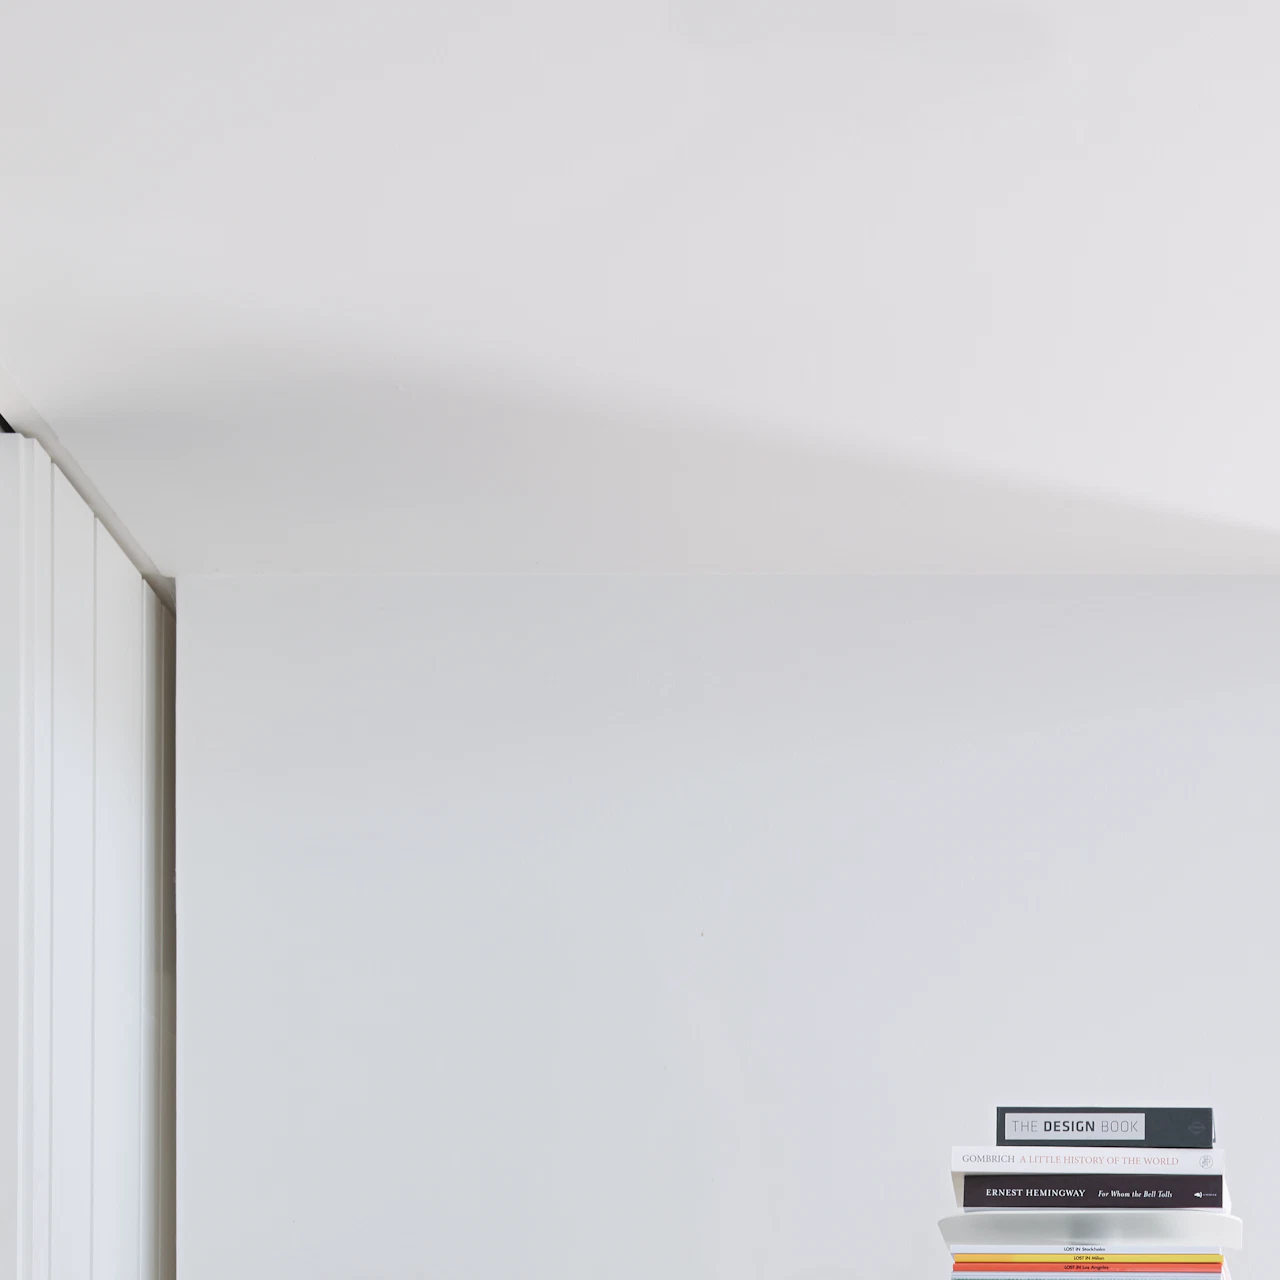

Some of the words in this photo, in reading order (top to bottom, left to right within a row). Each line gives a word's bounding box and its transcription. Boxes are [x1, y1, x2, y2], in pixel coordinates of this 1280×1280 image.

[1012, 1120, 1037, 1132] THE
[1044, 1120, 1095, 1133] DESIGN
[1101, 1120, 1138, 1132] BOOK
[962, 1154, 1015, 1163] GOMBRICH
[1020, 1155, 1026, 1163] A
[1028, 1155, 1061, 1164] LITTLE
[1063, 1156, 1105, 1164] HISTORY
[1107, 1156, 1119, 1164] OF
[1123, 1157, 1141, 1165] THE
[1143, 1157, 1178, 1165] WORLD
[986, 1189, 1023, 1197] ERNEST
[1026, 1189, 1085, 1197] HEMINGWAY
[1098, 1190, 1110, 1198] For
[1112, 1190, 1130, 1198] Whom
[1132, 1190, 1142, 1198] the
[1143, 1190, 1156, 1198] Bell
[1157, 1190, 1172, 1198] Tolls
